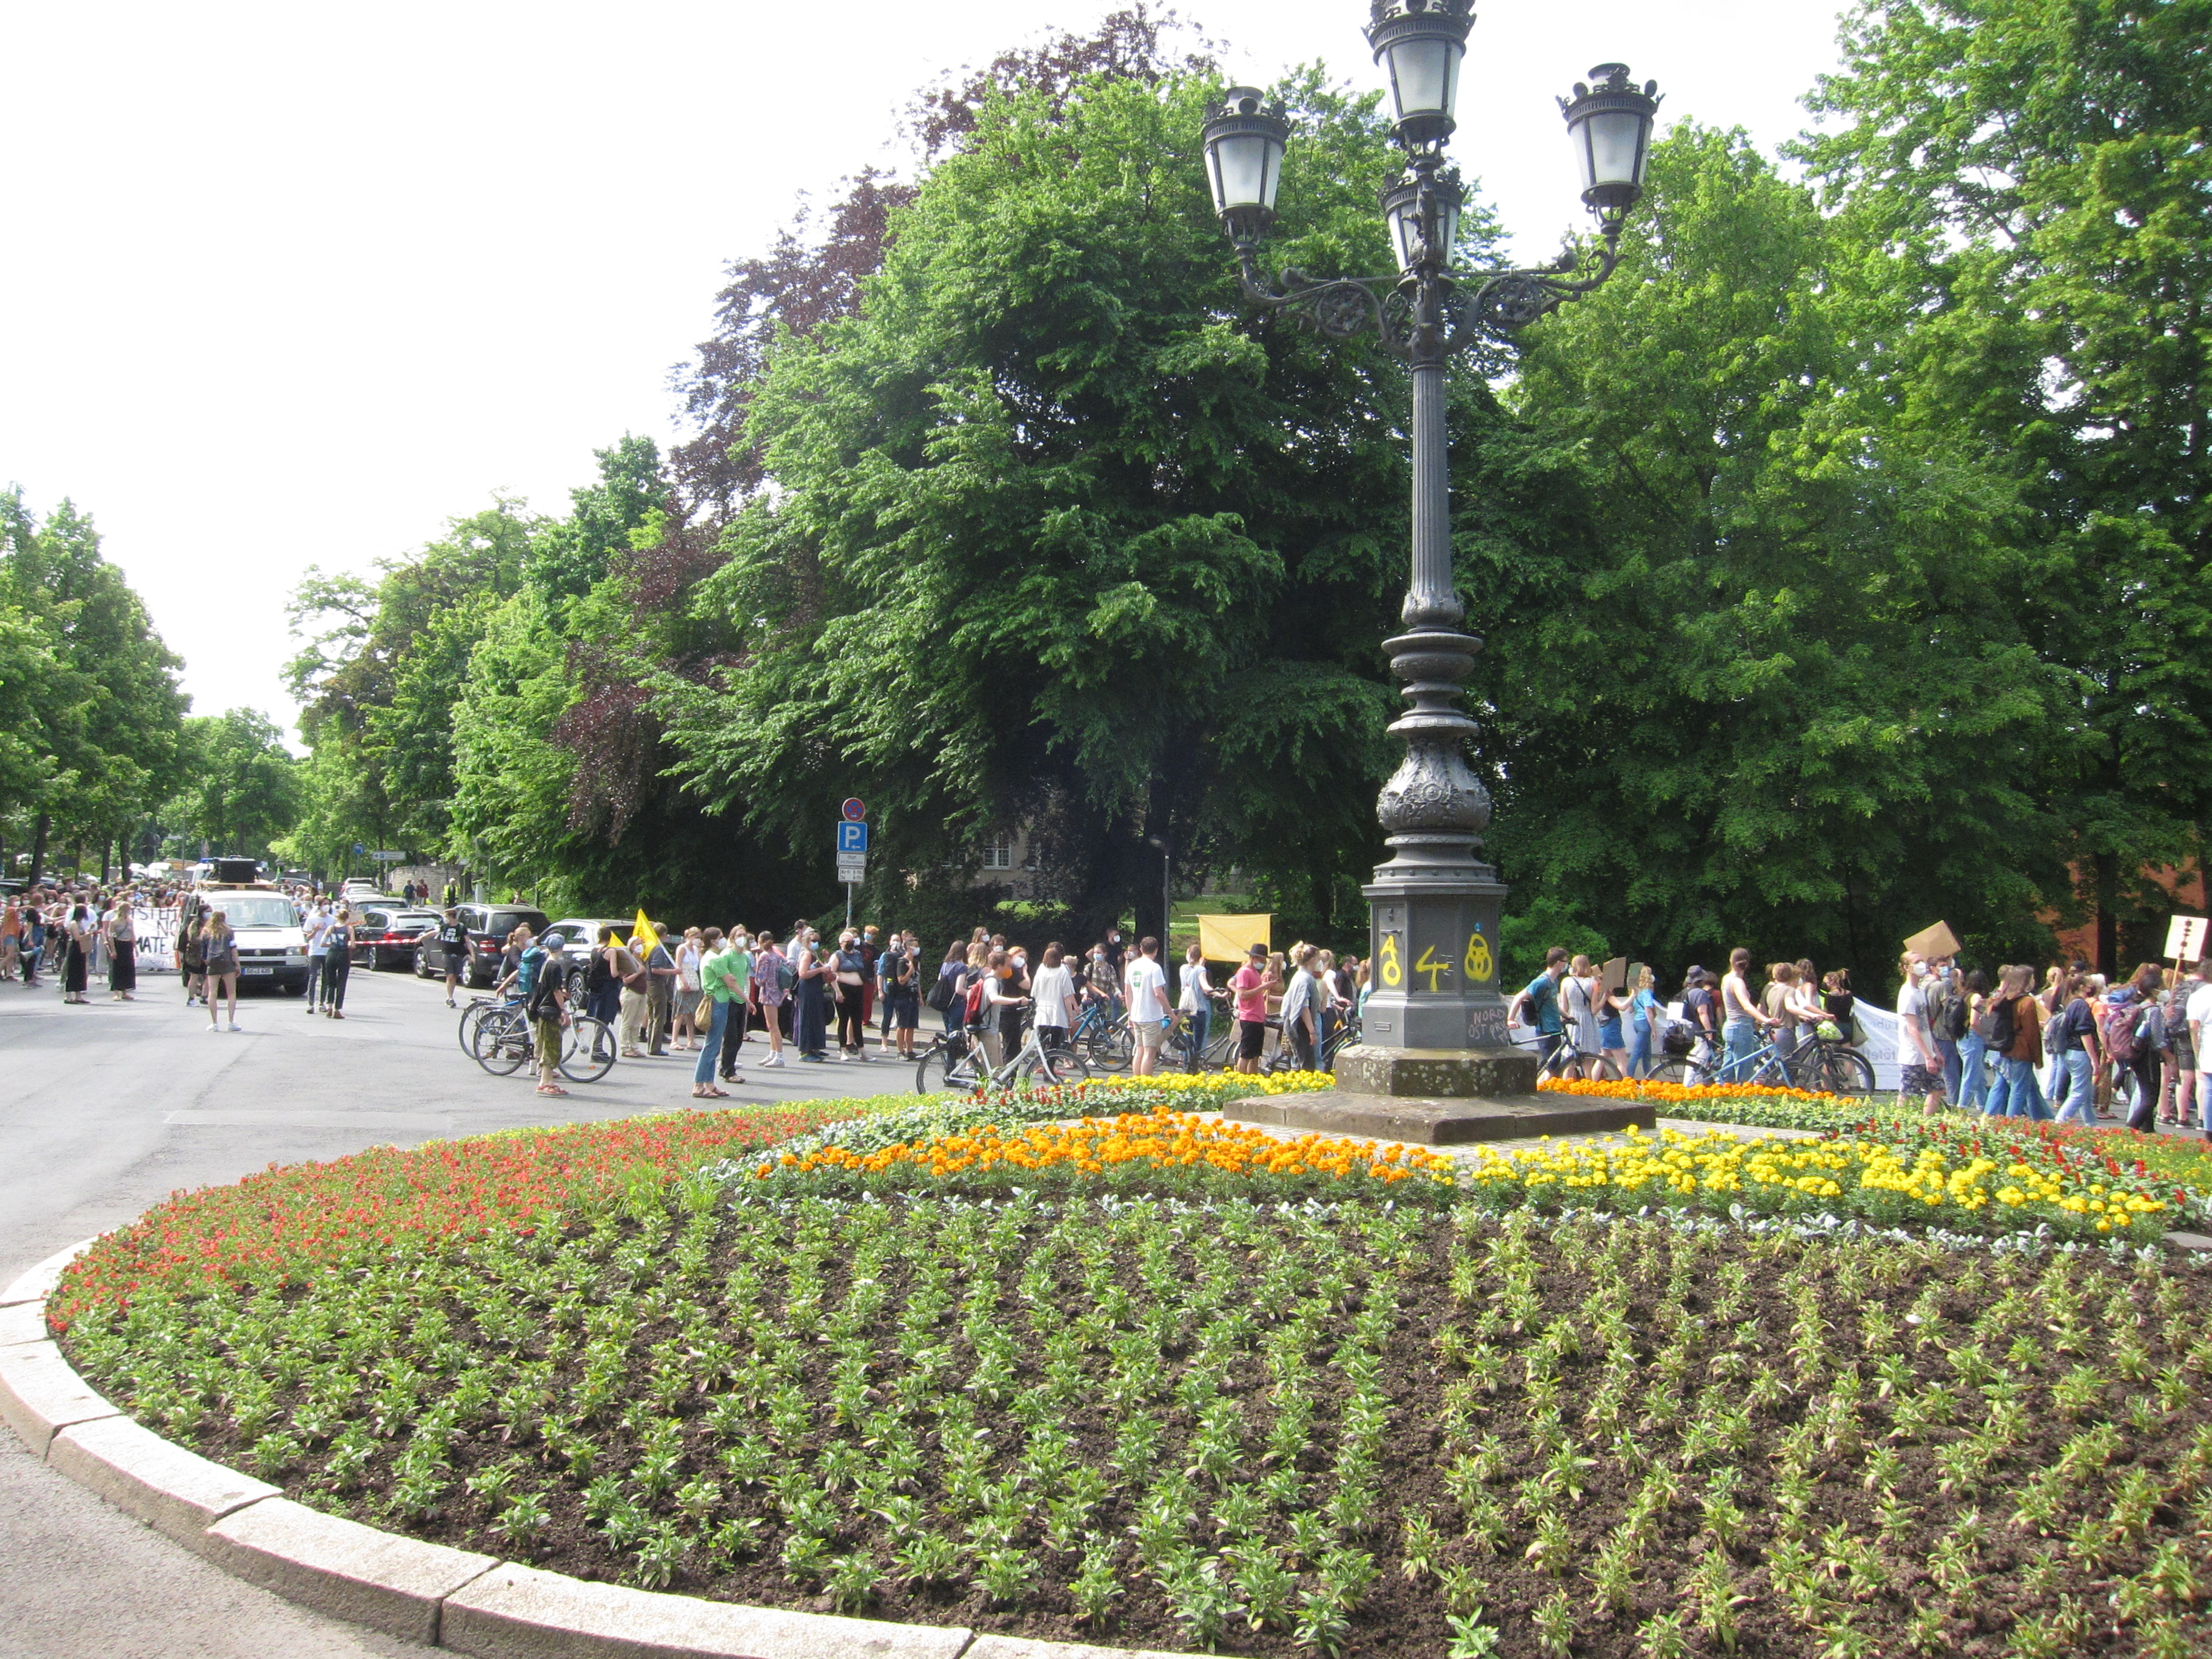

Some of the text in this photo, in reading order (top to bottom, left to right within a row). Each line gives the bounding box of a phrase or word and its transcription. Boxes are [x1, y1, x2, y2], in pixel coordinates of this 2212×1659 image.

[845, 825, 860, 848] P
[1473, 1008, 1505, 1025] NORD
[1468, 1024, 1487, 1039] OST
